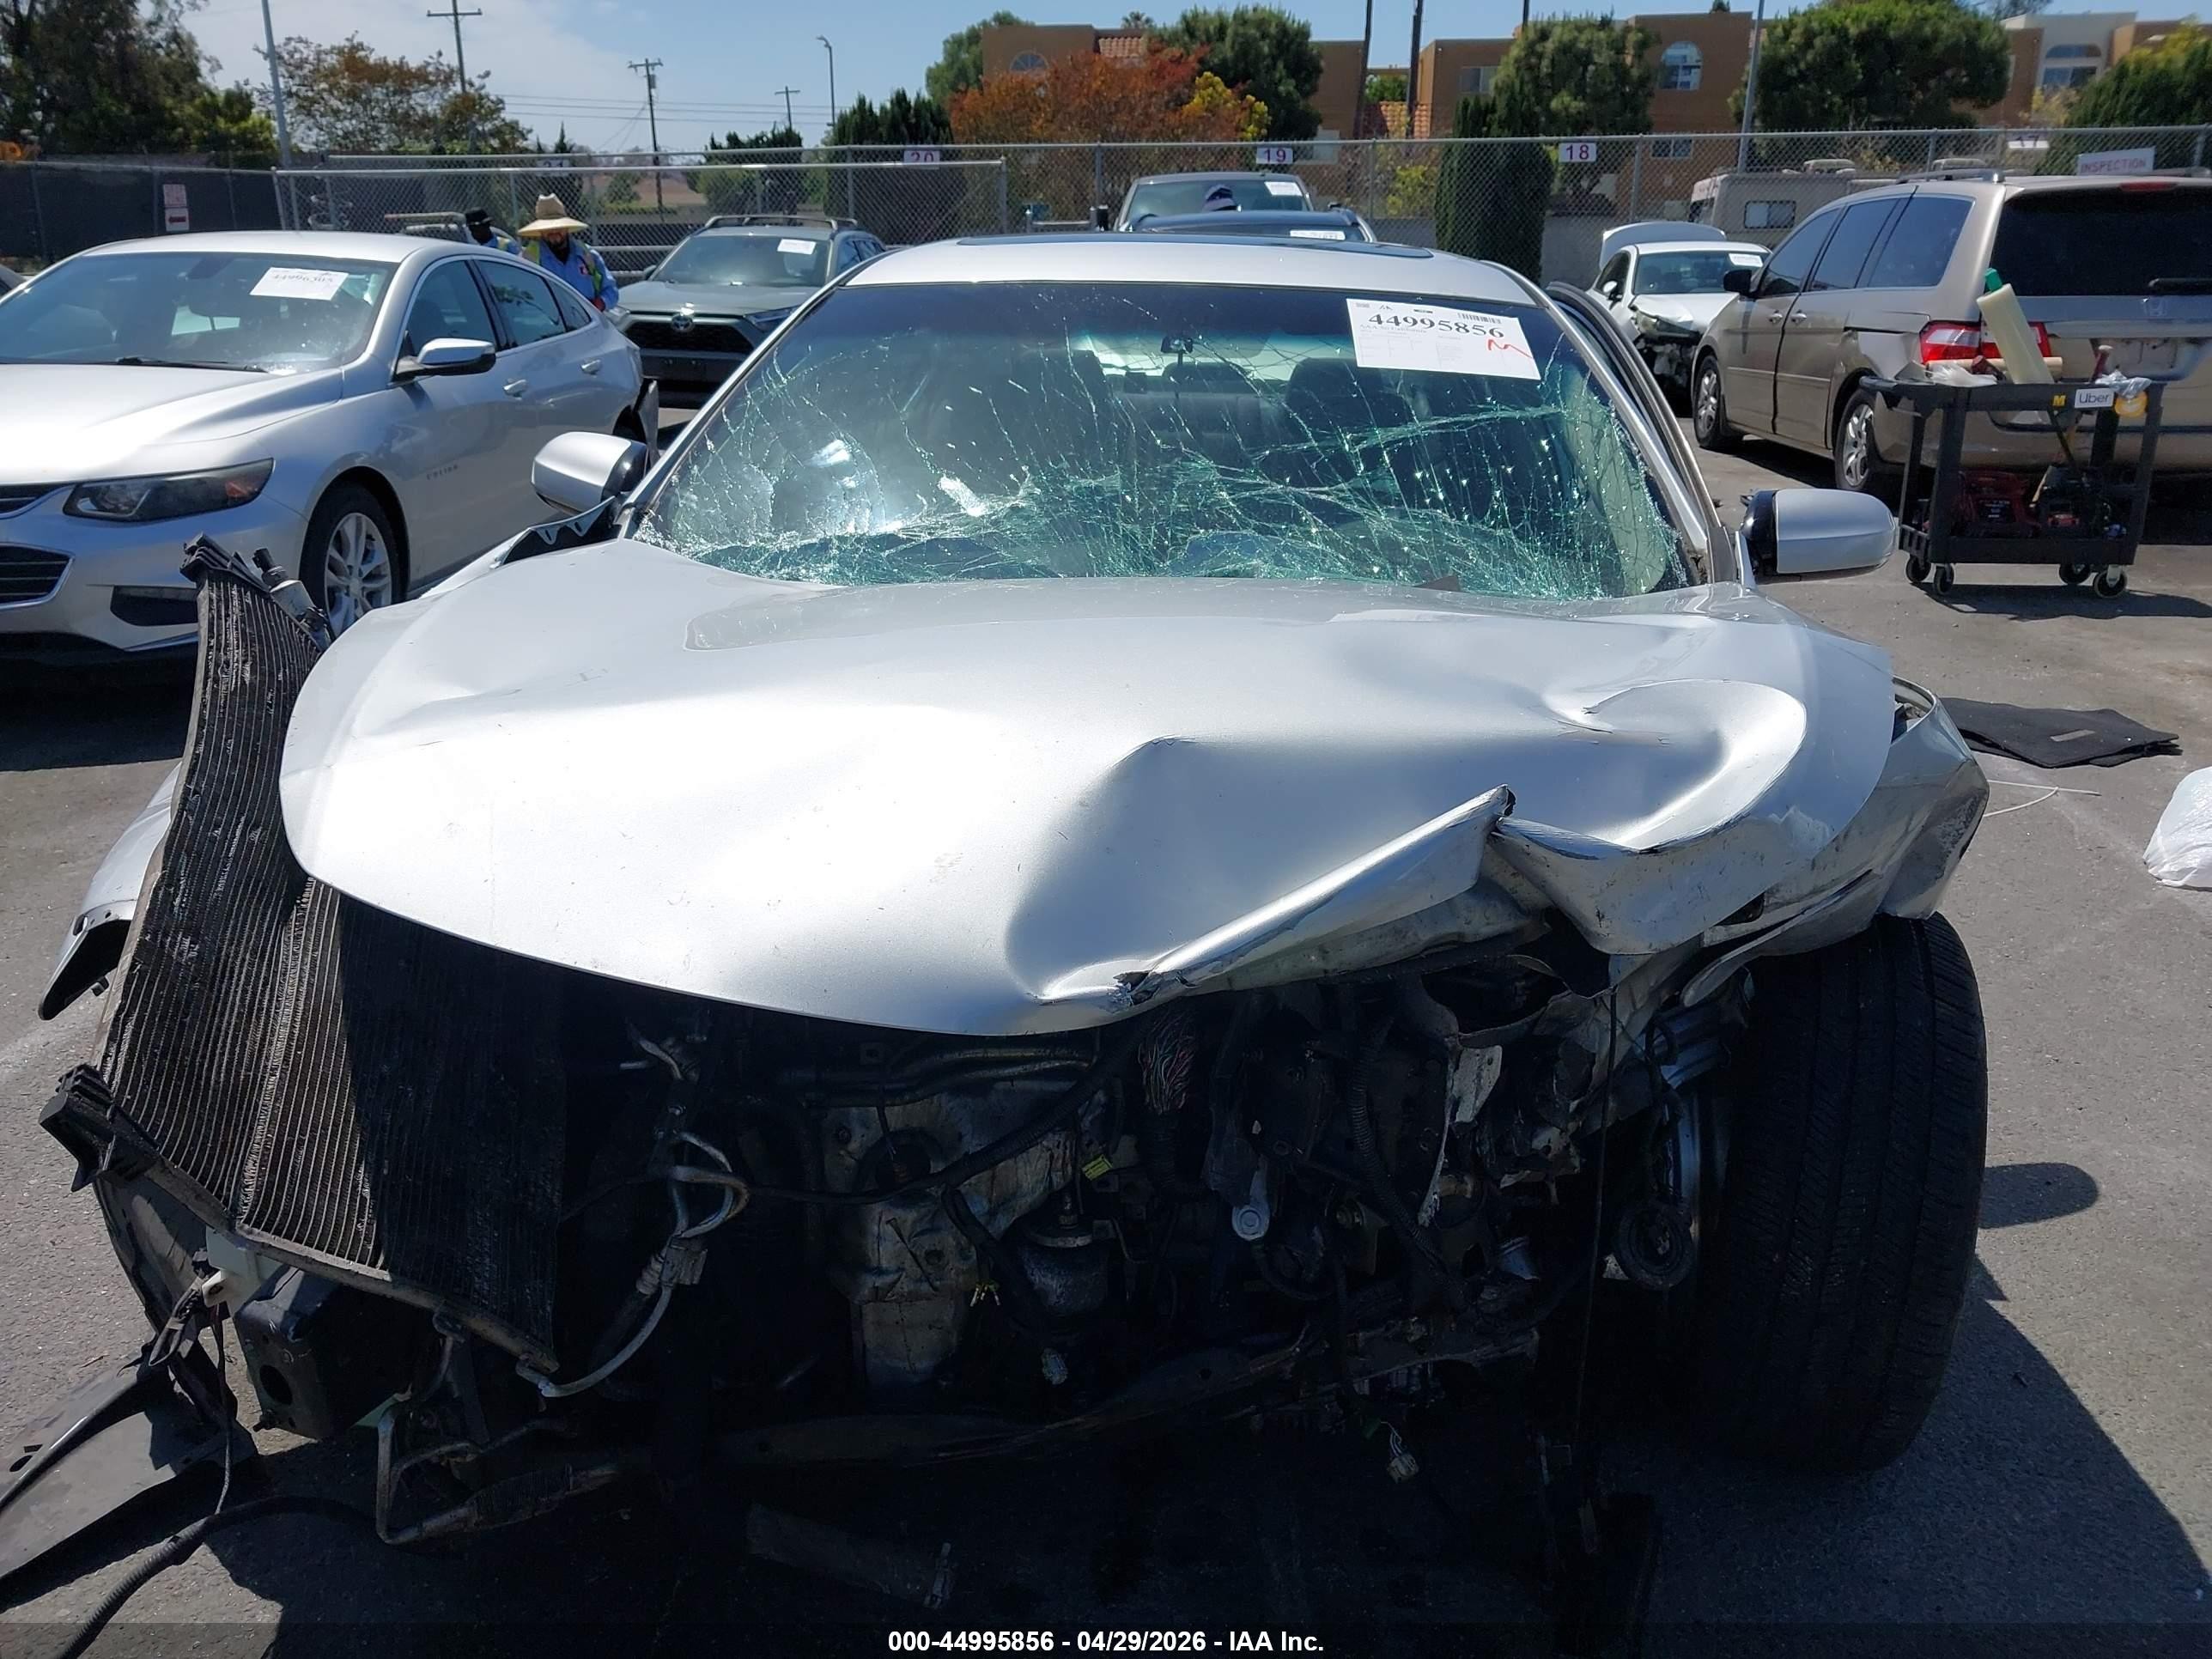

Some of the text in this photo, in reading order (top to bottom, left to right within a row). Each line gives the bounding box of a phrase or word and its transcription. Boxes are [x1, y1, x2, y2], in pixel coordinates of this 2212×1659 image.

[1264, 148, 1286, 163] 19
[1565, 144, 1589, 161] 18
[2081, 158, 2146, 173] INSPECTION
[1368, 313, 1504, 338] 44995856
[2079, 392, 2110, 404] Uber
